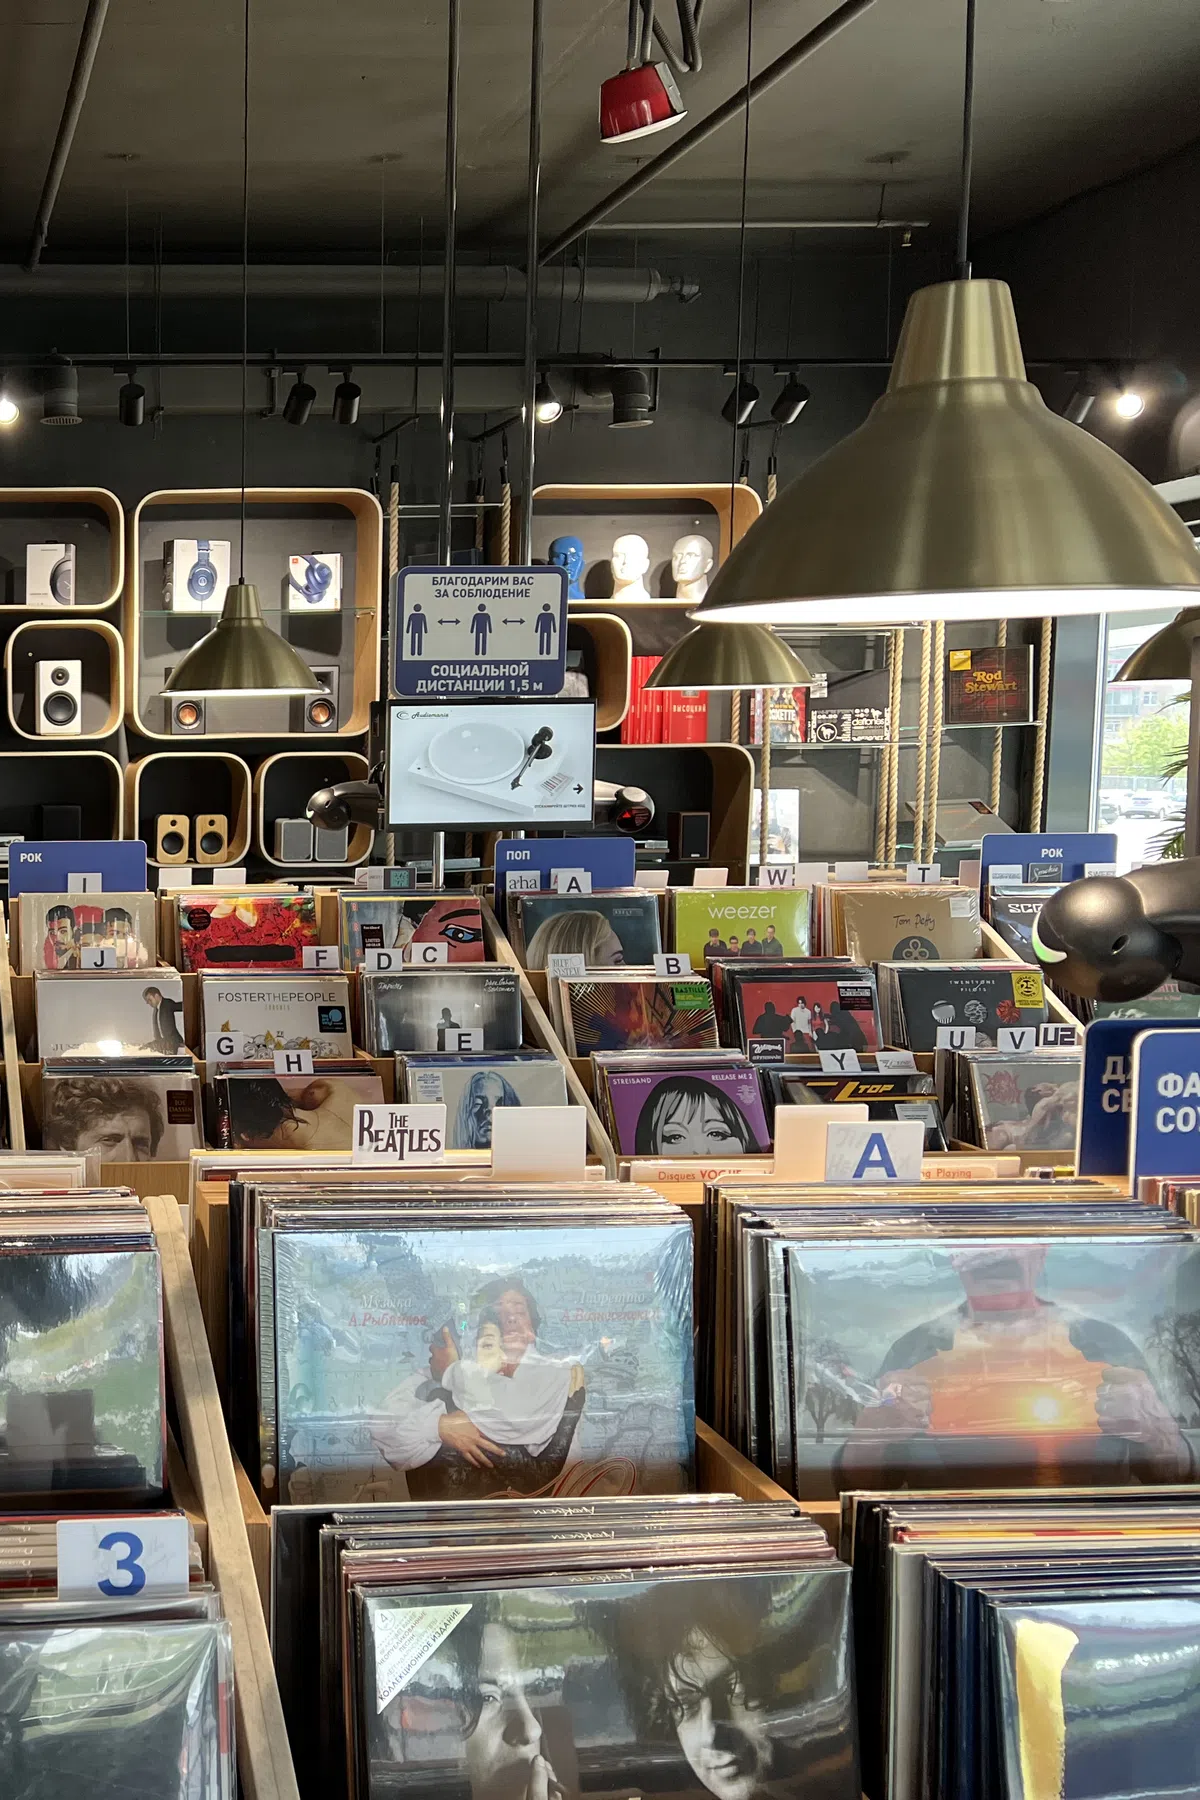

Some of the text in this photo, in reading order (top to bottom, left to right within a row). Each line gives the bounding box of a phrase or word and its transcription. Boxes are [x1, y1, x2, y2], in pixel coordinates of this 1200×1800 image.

[431, 576, 535, 587] БЛАГОДАРИМ ВАС
[434, 588, 531, 599] ЗА СОБЛЮДЕНИЕ
[430, 661, 530, 679] СОЦИАЛЬНОЙ
[972, 671, 1003, 683] Rod
[416, 679, 506, 694] ДИСТАНЦИИ
[509, 679, 530, 693] 1,5
[965, 681, 1018, 694] Stewart
[411, 710, 449, 719] Audiomania
[20, 853, 43, 863] РОК
[506, 850, 531, 861] ПОП
[1041, 848, 1064, 858] РОК
[767, 869, 788, 885] W
[917, 867, 931, 882] T
[566, 876, 582, 893] A
[708, 905, 778, 919] weezer
[893, 914, 936, 931] Tom Petty
[93, 950, 104, 967] J
[315, 950, 328, 967] F
[376, 953, 392, 970] D
[422, 946, 438, 963] C
[553, 967, 581, 976] SYSTEM
[665, 957, 681, 974] B
[457, 1032, 472, 1051] E
[950, 1031, 966, 1049] U
[1010, 1031, 1026, 1049] V
[1043, 1027, 1075, 1045] U2
[216, 1036, 234, 1056] G
[285, 1053, 303, 1072] H
[831, 1052, 846, 1070] Y
[612, 1077, 652, 1085] STREISAND
[711, 1073, 737, 1081] RELEASE
[857, 1084, 895, 1094] TOP
[389, 1112, 408, 1129] THE
[1156, 1106, 1200, 1134] СО
[852, 1132, 898, 1179] А
[658, 1171, 695, 1182] Disques
[936, 1168, 972, 1179] Playing
[380, 1613, 388, 1623] 4
[399, 1633, 417, 1652] ПЕСНИ
[378, 1607, 461, 1702] КОЛЛЕКЦИОННОЕ ИЗДАНИЕ
